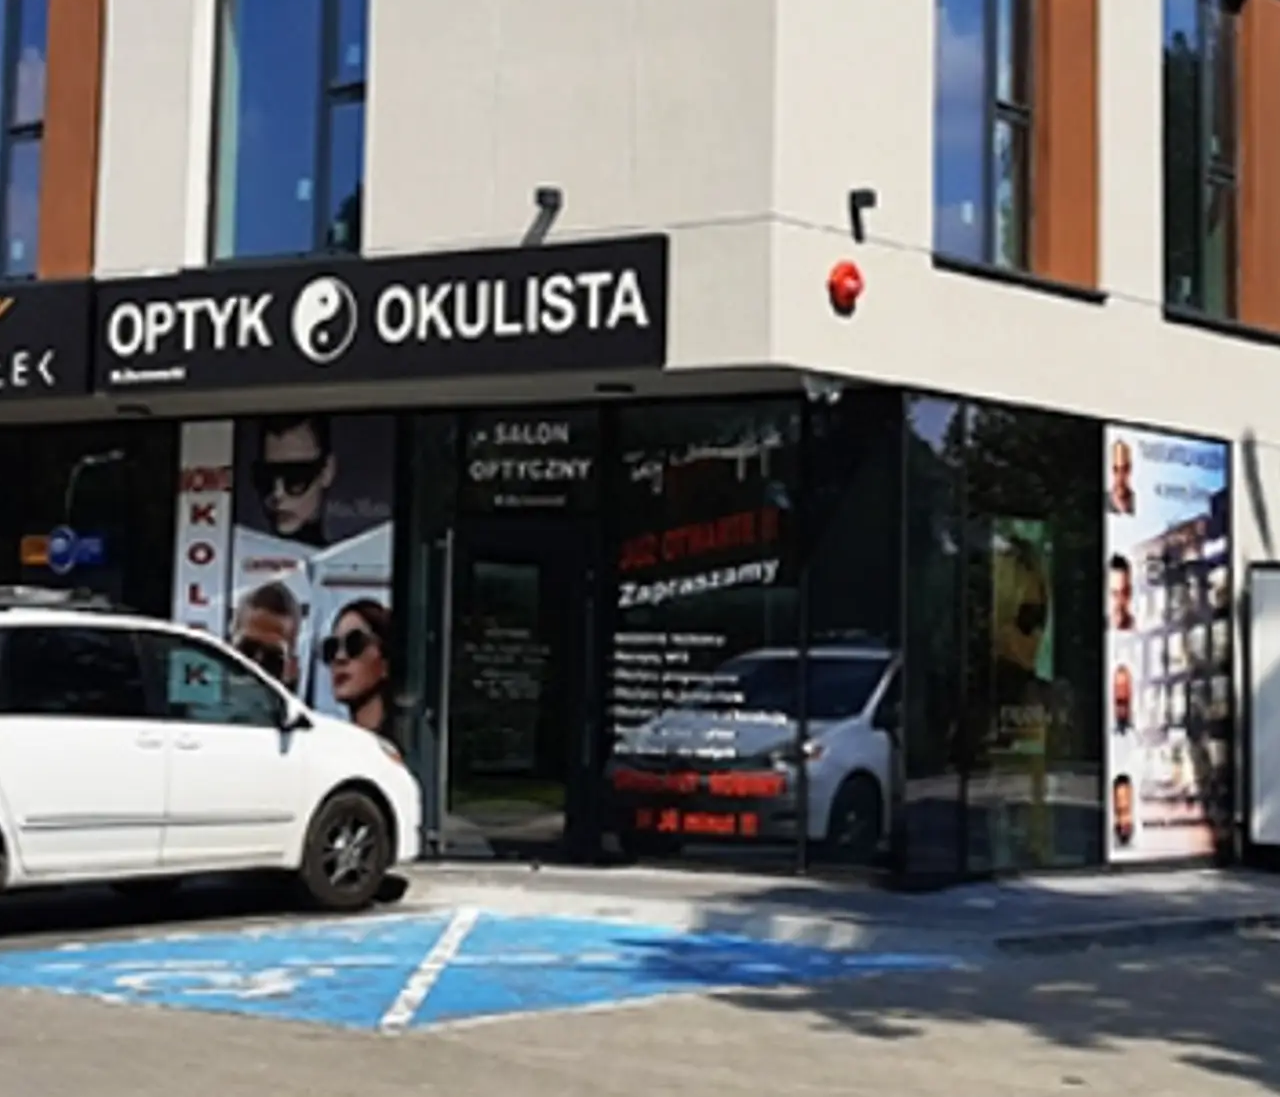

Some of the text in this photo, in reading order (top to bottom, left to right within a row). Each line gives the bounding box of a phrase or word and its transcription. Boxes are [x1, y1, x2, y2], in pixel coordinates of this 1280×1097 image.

[108, 268, 649, 356] OPTYK OKULISTA
[494, 421, 569, 445] SALON
[468, 458, 593, 481] OPTYCZNY
[618, 558, 780, 607] Zapraszamy
